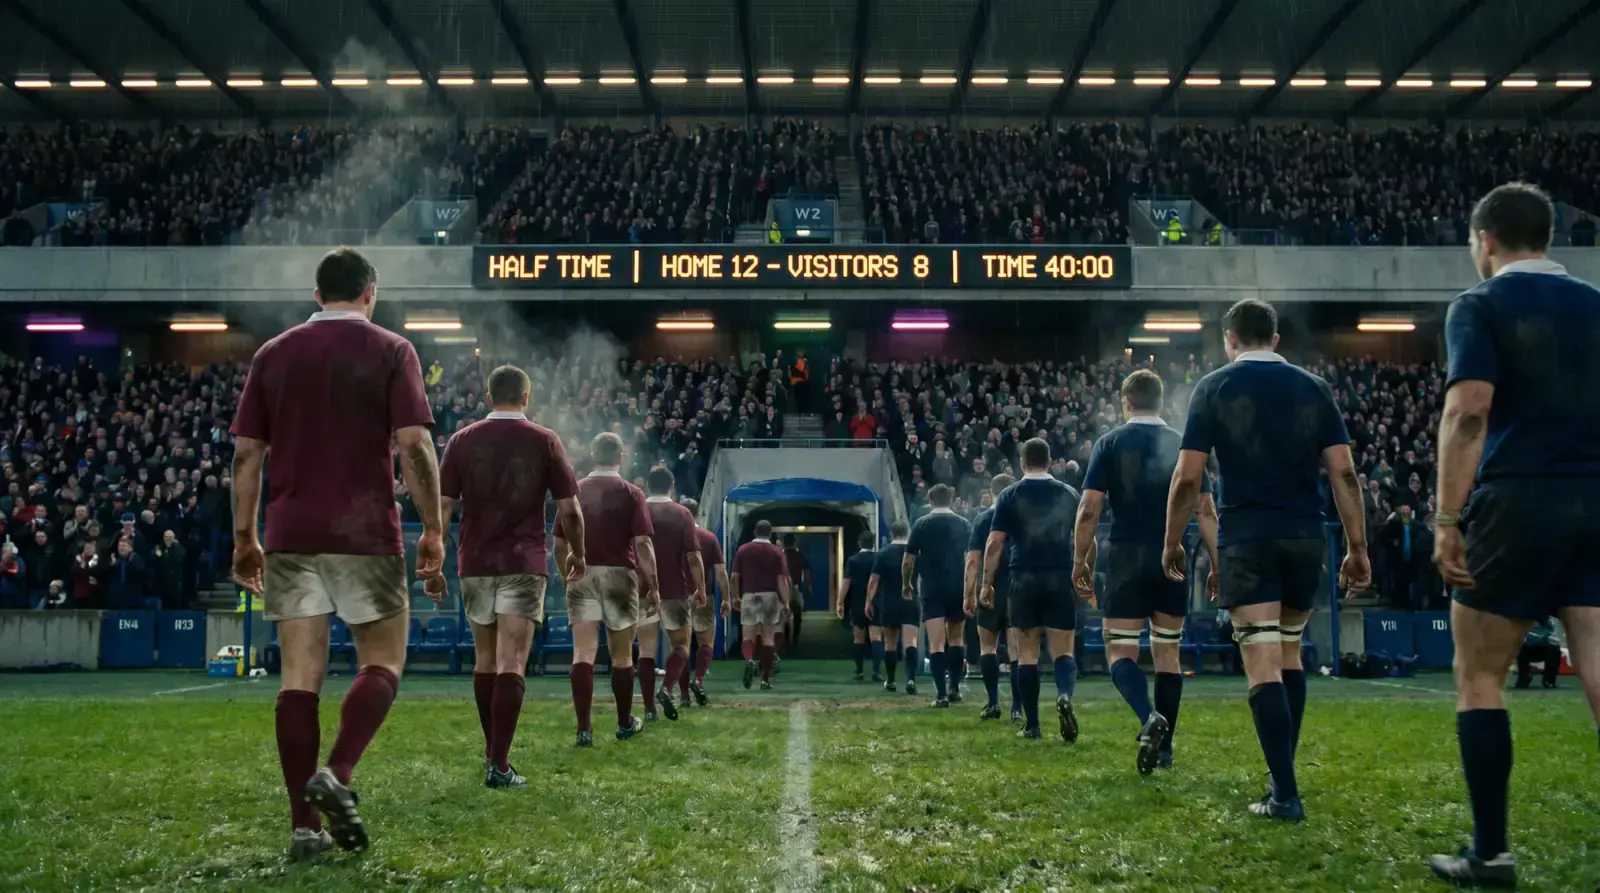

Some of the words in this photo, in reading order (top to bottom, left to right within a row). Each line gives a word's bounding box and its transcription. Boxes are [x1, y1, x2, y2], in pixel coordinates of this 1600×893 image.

[795, 208, 821, 220] W2
[488, 254, 549, 278] HALF
[557, 254, 612, 278] TIME
[661, 254, 724, 278] HOME
[731, 254, 759, 278] 12
[788, 254, 899, 278] VISITORS
[913, 254, 930, 278] 8
[982, 254, 1038, 278] TIME
[1044, 254, 1113, 278] 40:00
